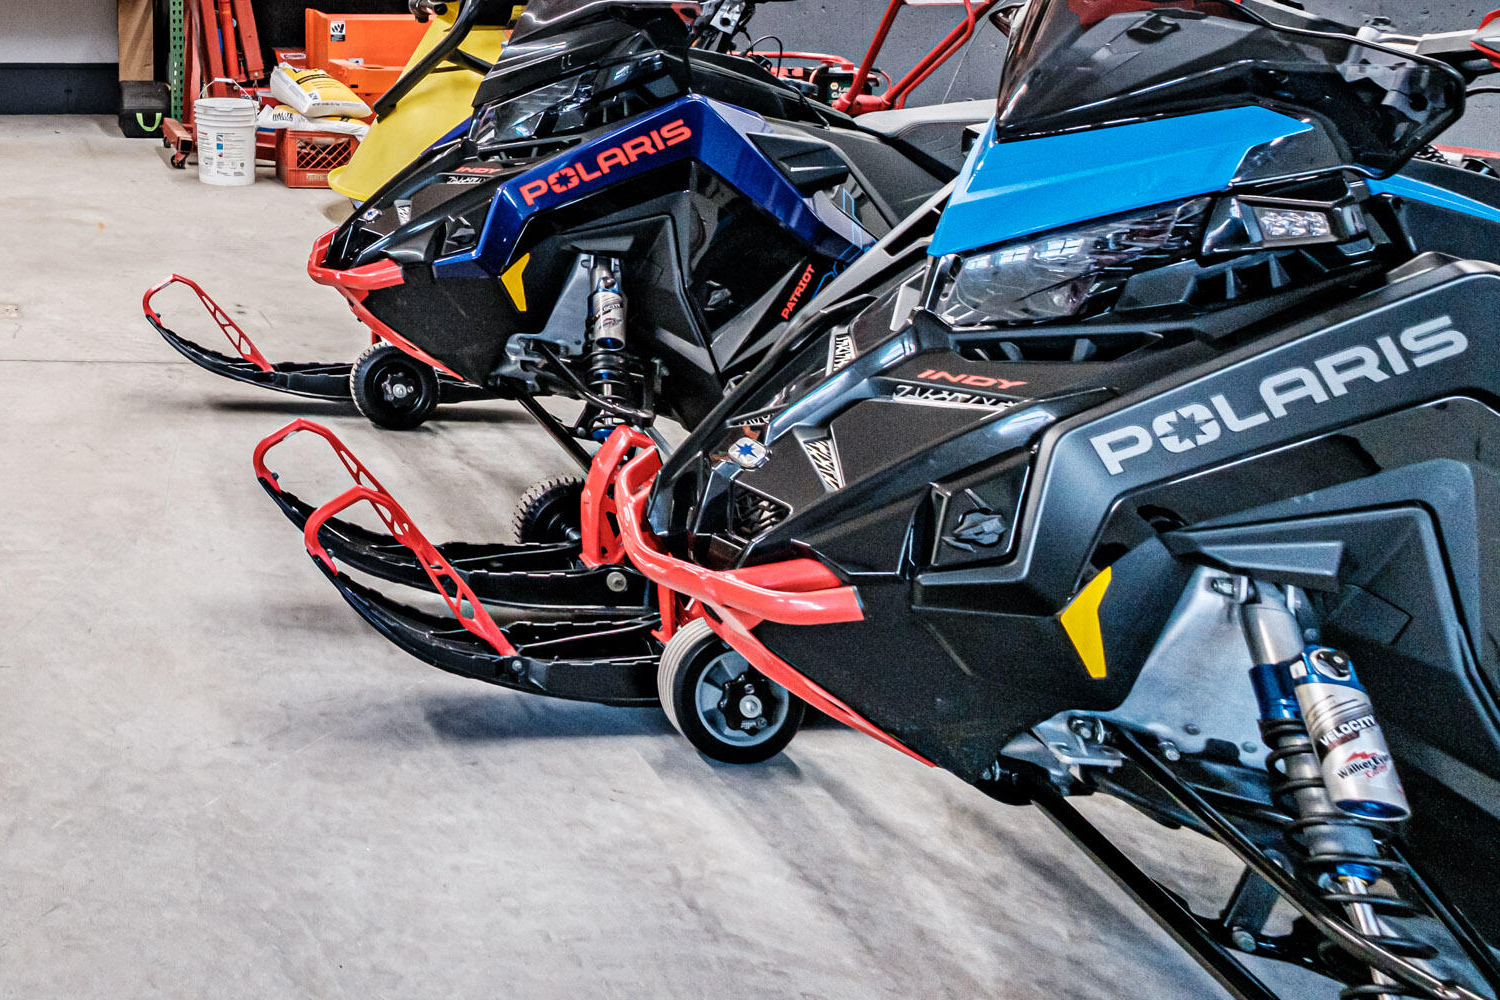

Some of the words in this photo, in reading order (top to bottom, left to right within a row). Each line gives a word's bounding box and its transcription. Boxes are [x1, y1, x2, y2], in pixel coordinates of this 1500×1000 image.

[453, 166, 503, 174] INDY
[519, 118, 692, 207] POLARIS
[780, 263, 815, 320] PATRIOT
[917, 369, 1028, 389] INDY
[1089, 315, 1469, 476] POLARIS
[1320, 714, 1376, 747] VELOCITY
